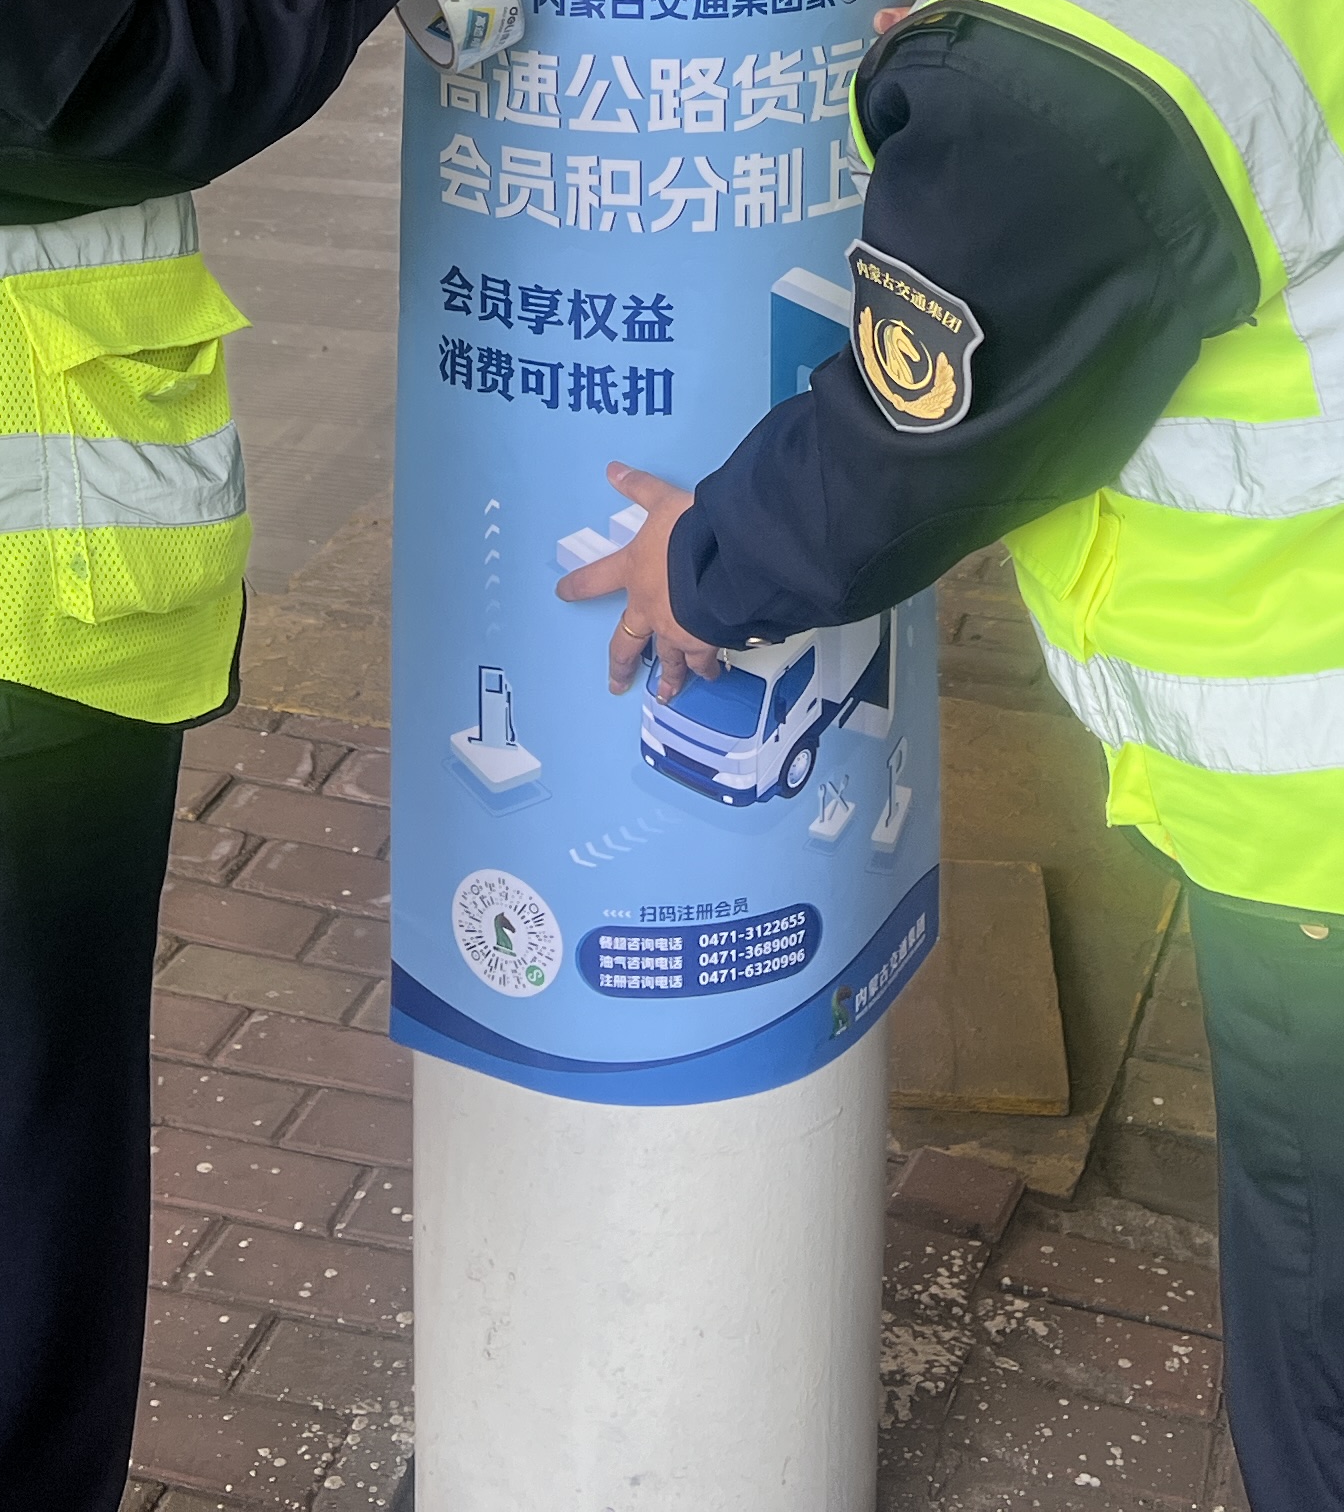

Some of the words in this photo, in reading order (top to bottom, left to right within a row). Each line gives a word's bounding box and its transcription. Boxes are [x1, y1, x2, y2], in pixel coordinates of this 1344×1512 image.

[440, 131, 864, 234] 会员积分制上
[440, 264, 674, 343] 会员享权益
[857, 258, 963, 334] 内蒙古交通集团
[438, 334, 675, 417] 消费可抵扣
[639, 897, 749, 923] 扫码注册会员
[698, 911, 806, 948] 0471-3122655
[599, 954, 683, 971] 油气咨询电话
[698, 930, 806, 967] 0471-3689007
[599, 973, 683, 990] 注册咨询电话
[698, 948, 806, 986] 0471-6320996
